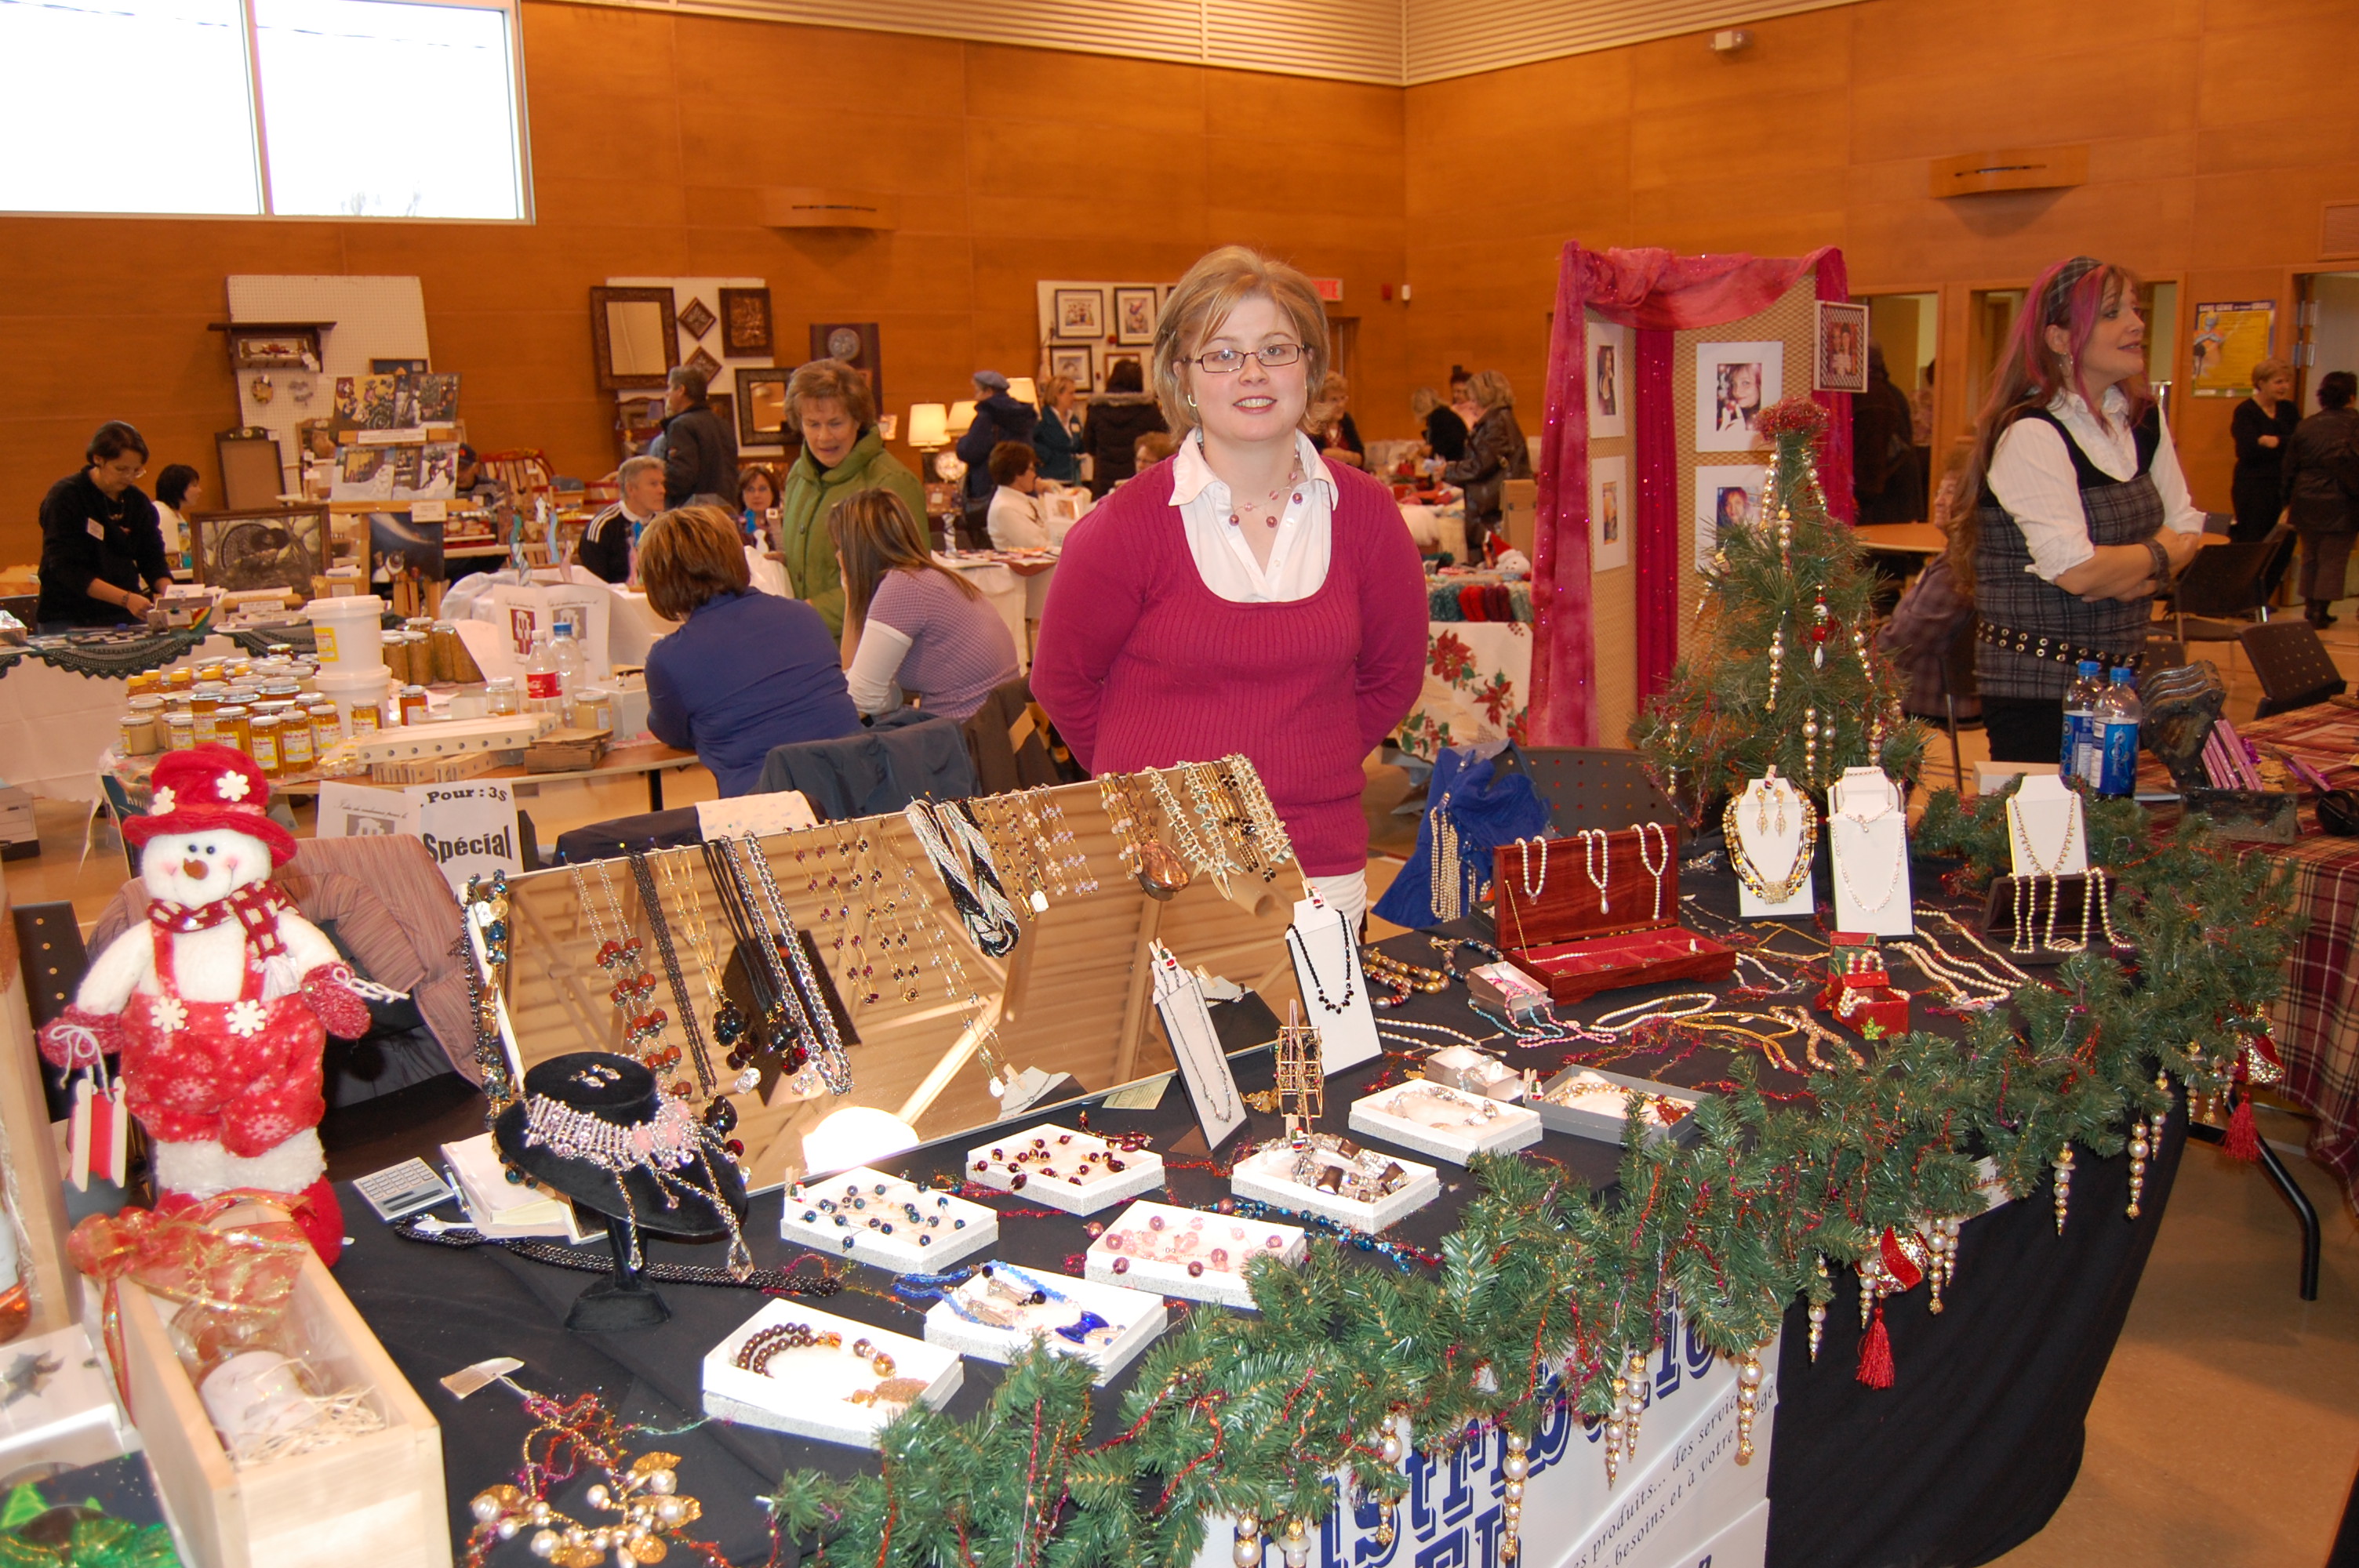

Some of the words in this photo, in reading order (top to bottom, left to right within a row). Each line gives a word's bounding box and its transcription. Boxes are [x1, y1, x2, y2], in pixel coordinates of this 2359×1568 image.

[427, 789, 474, 804] Pour
[423, 825, 513, 864] Spécial
[1672, 1441, 1693, 1471] des
[1615, 1504, 1666, 1566] besoins
[1670, 1486, 1683, 1506] et
[1688, 1470, 1695, 1487] à
[1699, 1429, 1733, 1472] votre
